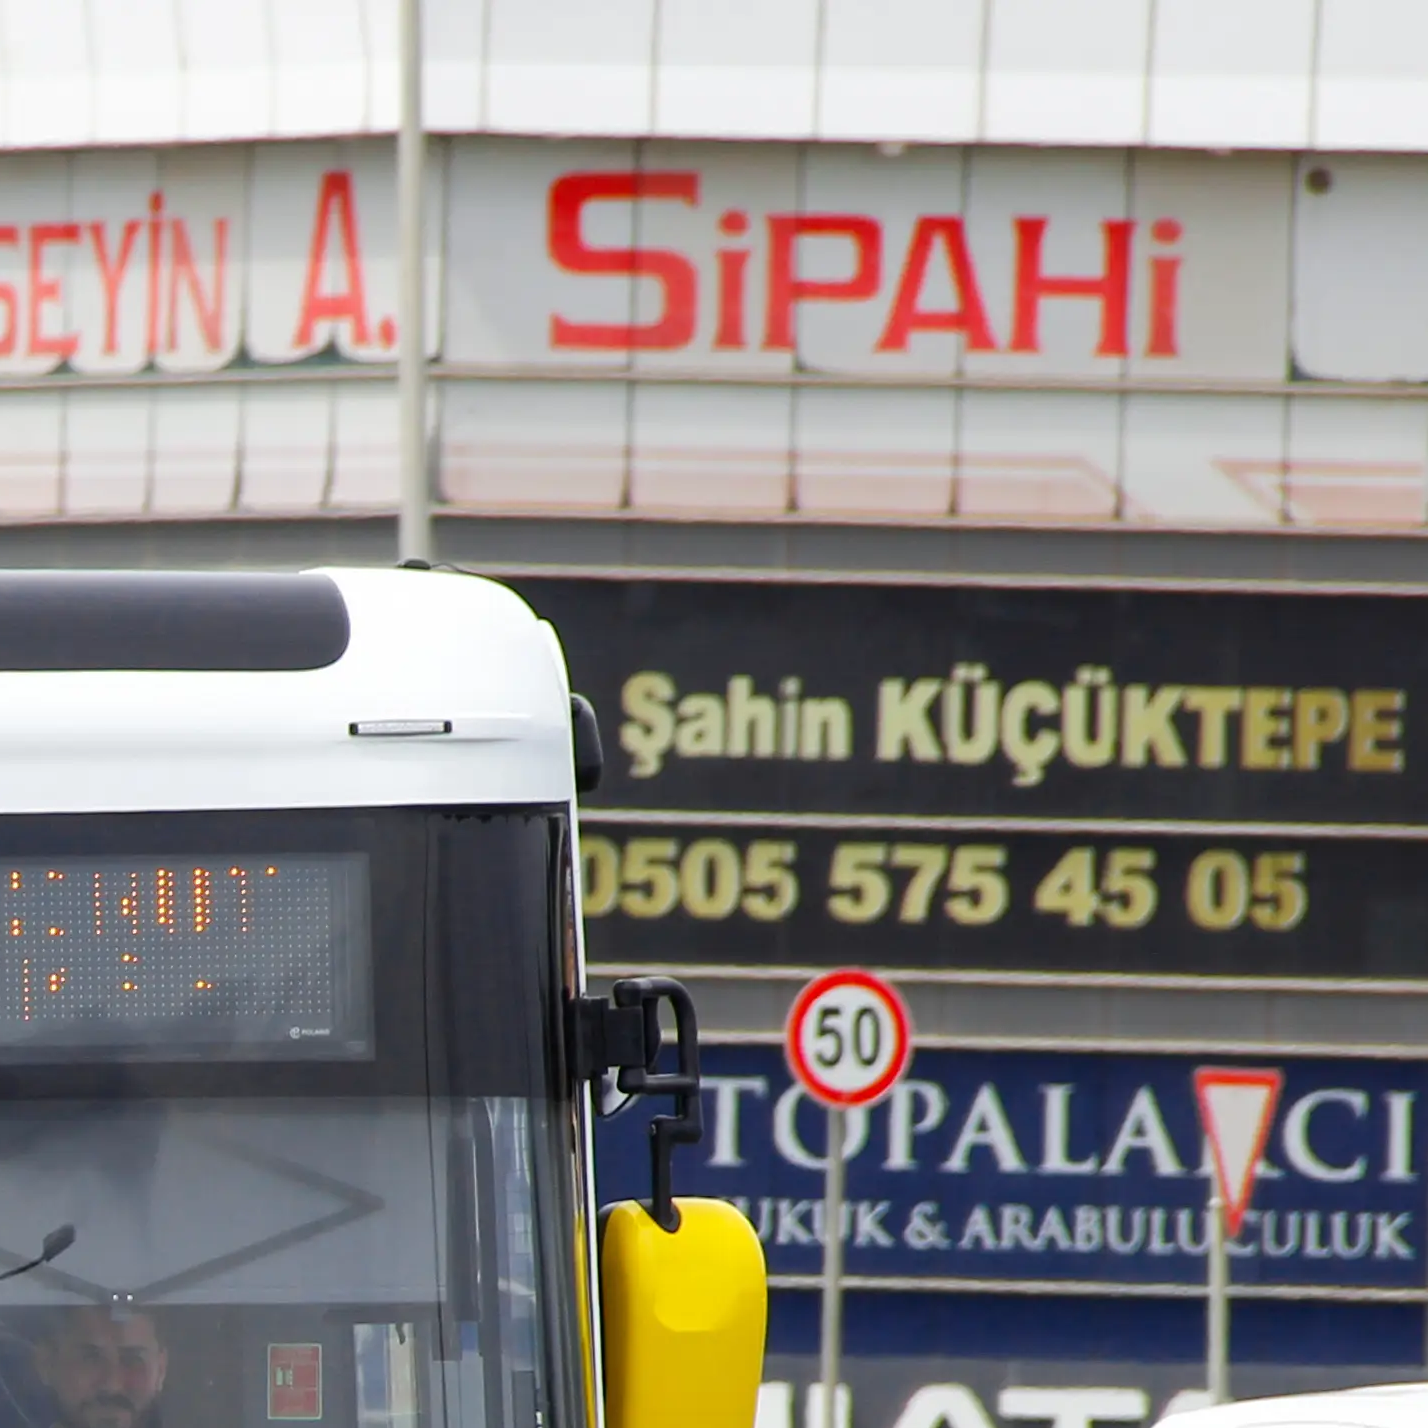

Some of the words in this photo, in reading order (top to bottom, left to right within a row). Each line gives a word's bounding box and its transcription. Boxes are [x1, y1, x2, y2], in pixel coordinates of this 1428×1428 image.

[294, 169, 398, 351] A.
[620, 670, 852, 778] Şahin
[875, 664, 1407, 787] KÜÇÜKTEPE
[580, 835, 799, 920] 0505
[828, 841, 1011, 926] 575
[1034, 846, 1158, 930] 45
[1185, 849, 1309, 932] 05
[813, 1007, 882, 1068] 50
[699, 1073, 1419, 1182] TOPALACI
[903, 1200, 953, 1250] &
